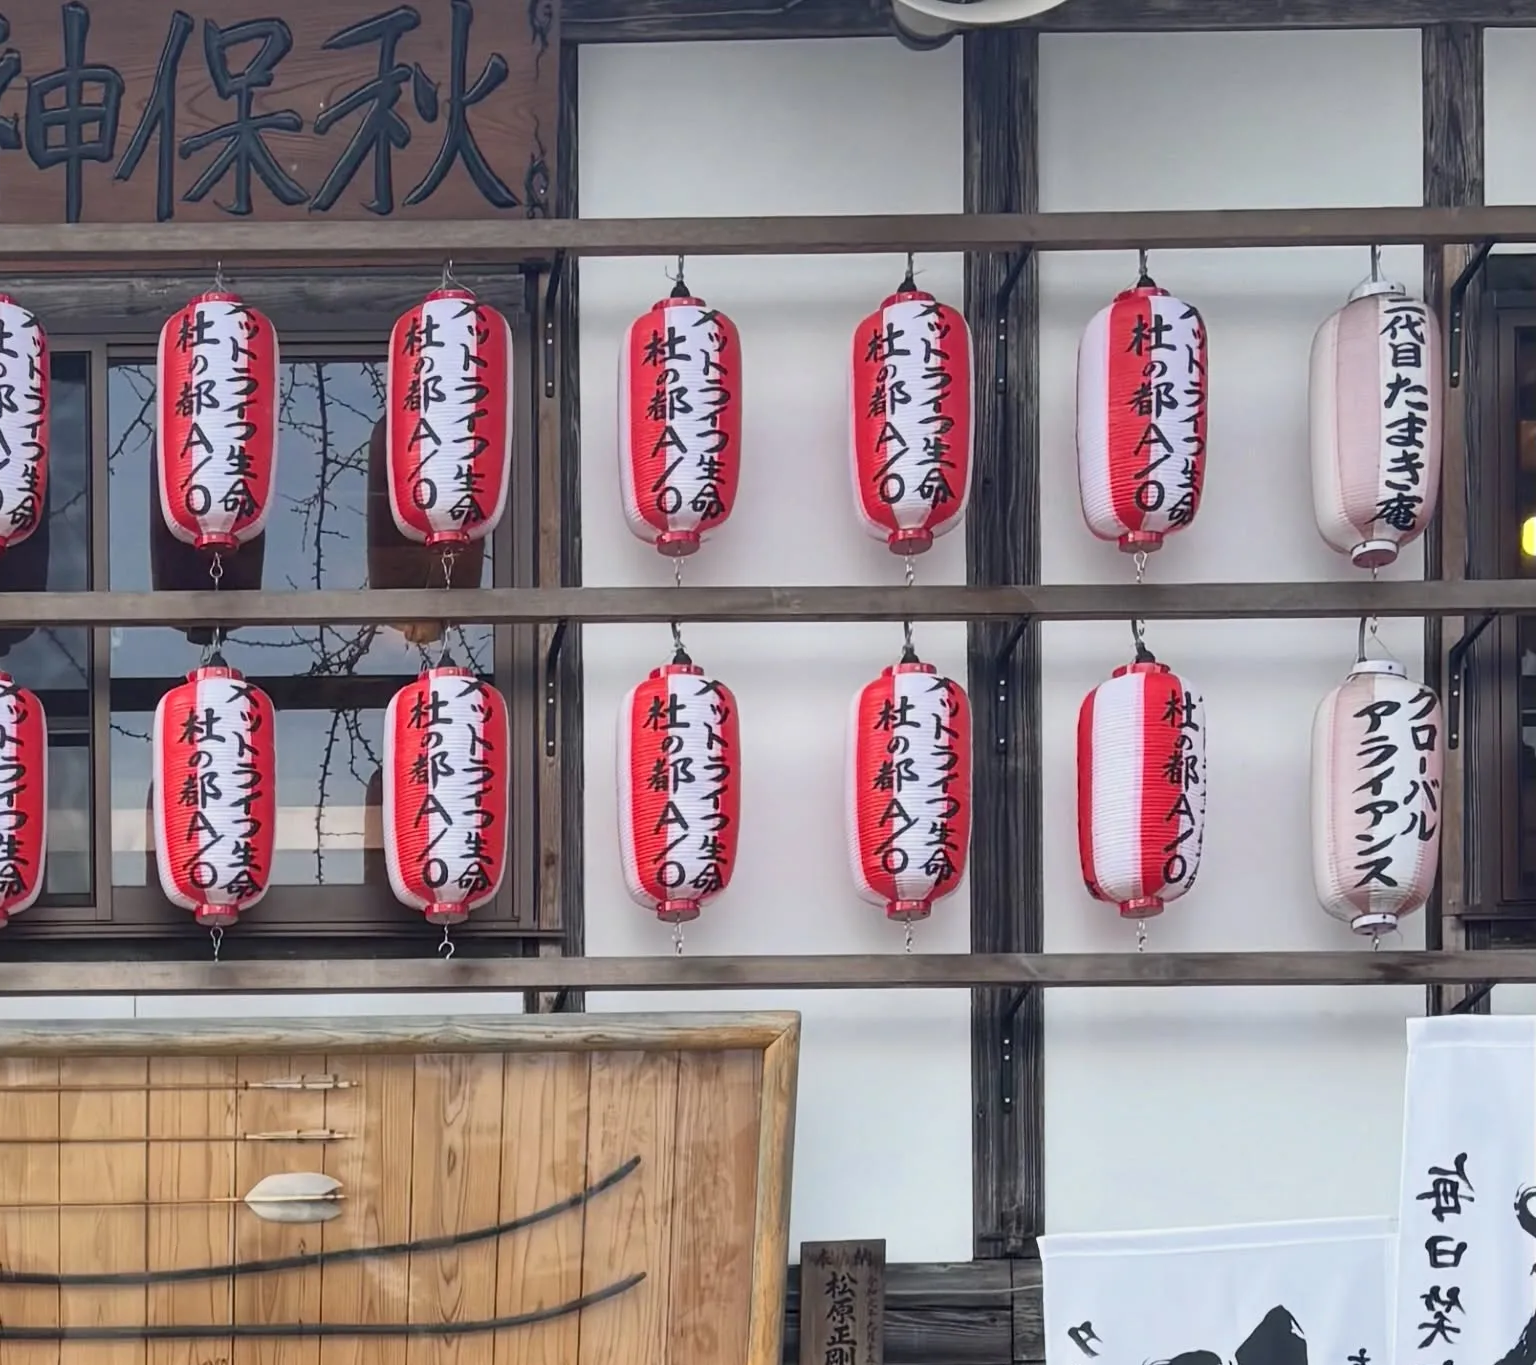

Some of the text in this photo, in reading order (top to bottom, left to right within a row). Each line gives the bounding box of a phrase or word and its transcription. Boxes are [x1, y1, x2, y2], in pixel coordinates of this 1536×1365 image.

[1369, 298, 1430, 532] 二代目たまき庵
[1353, 700, 1402, 887] アライアンス
